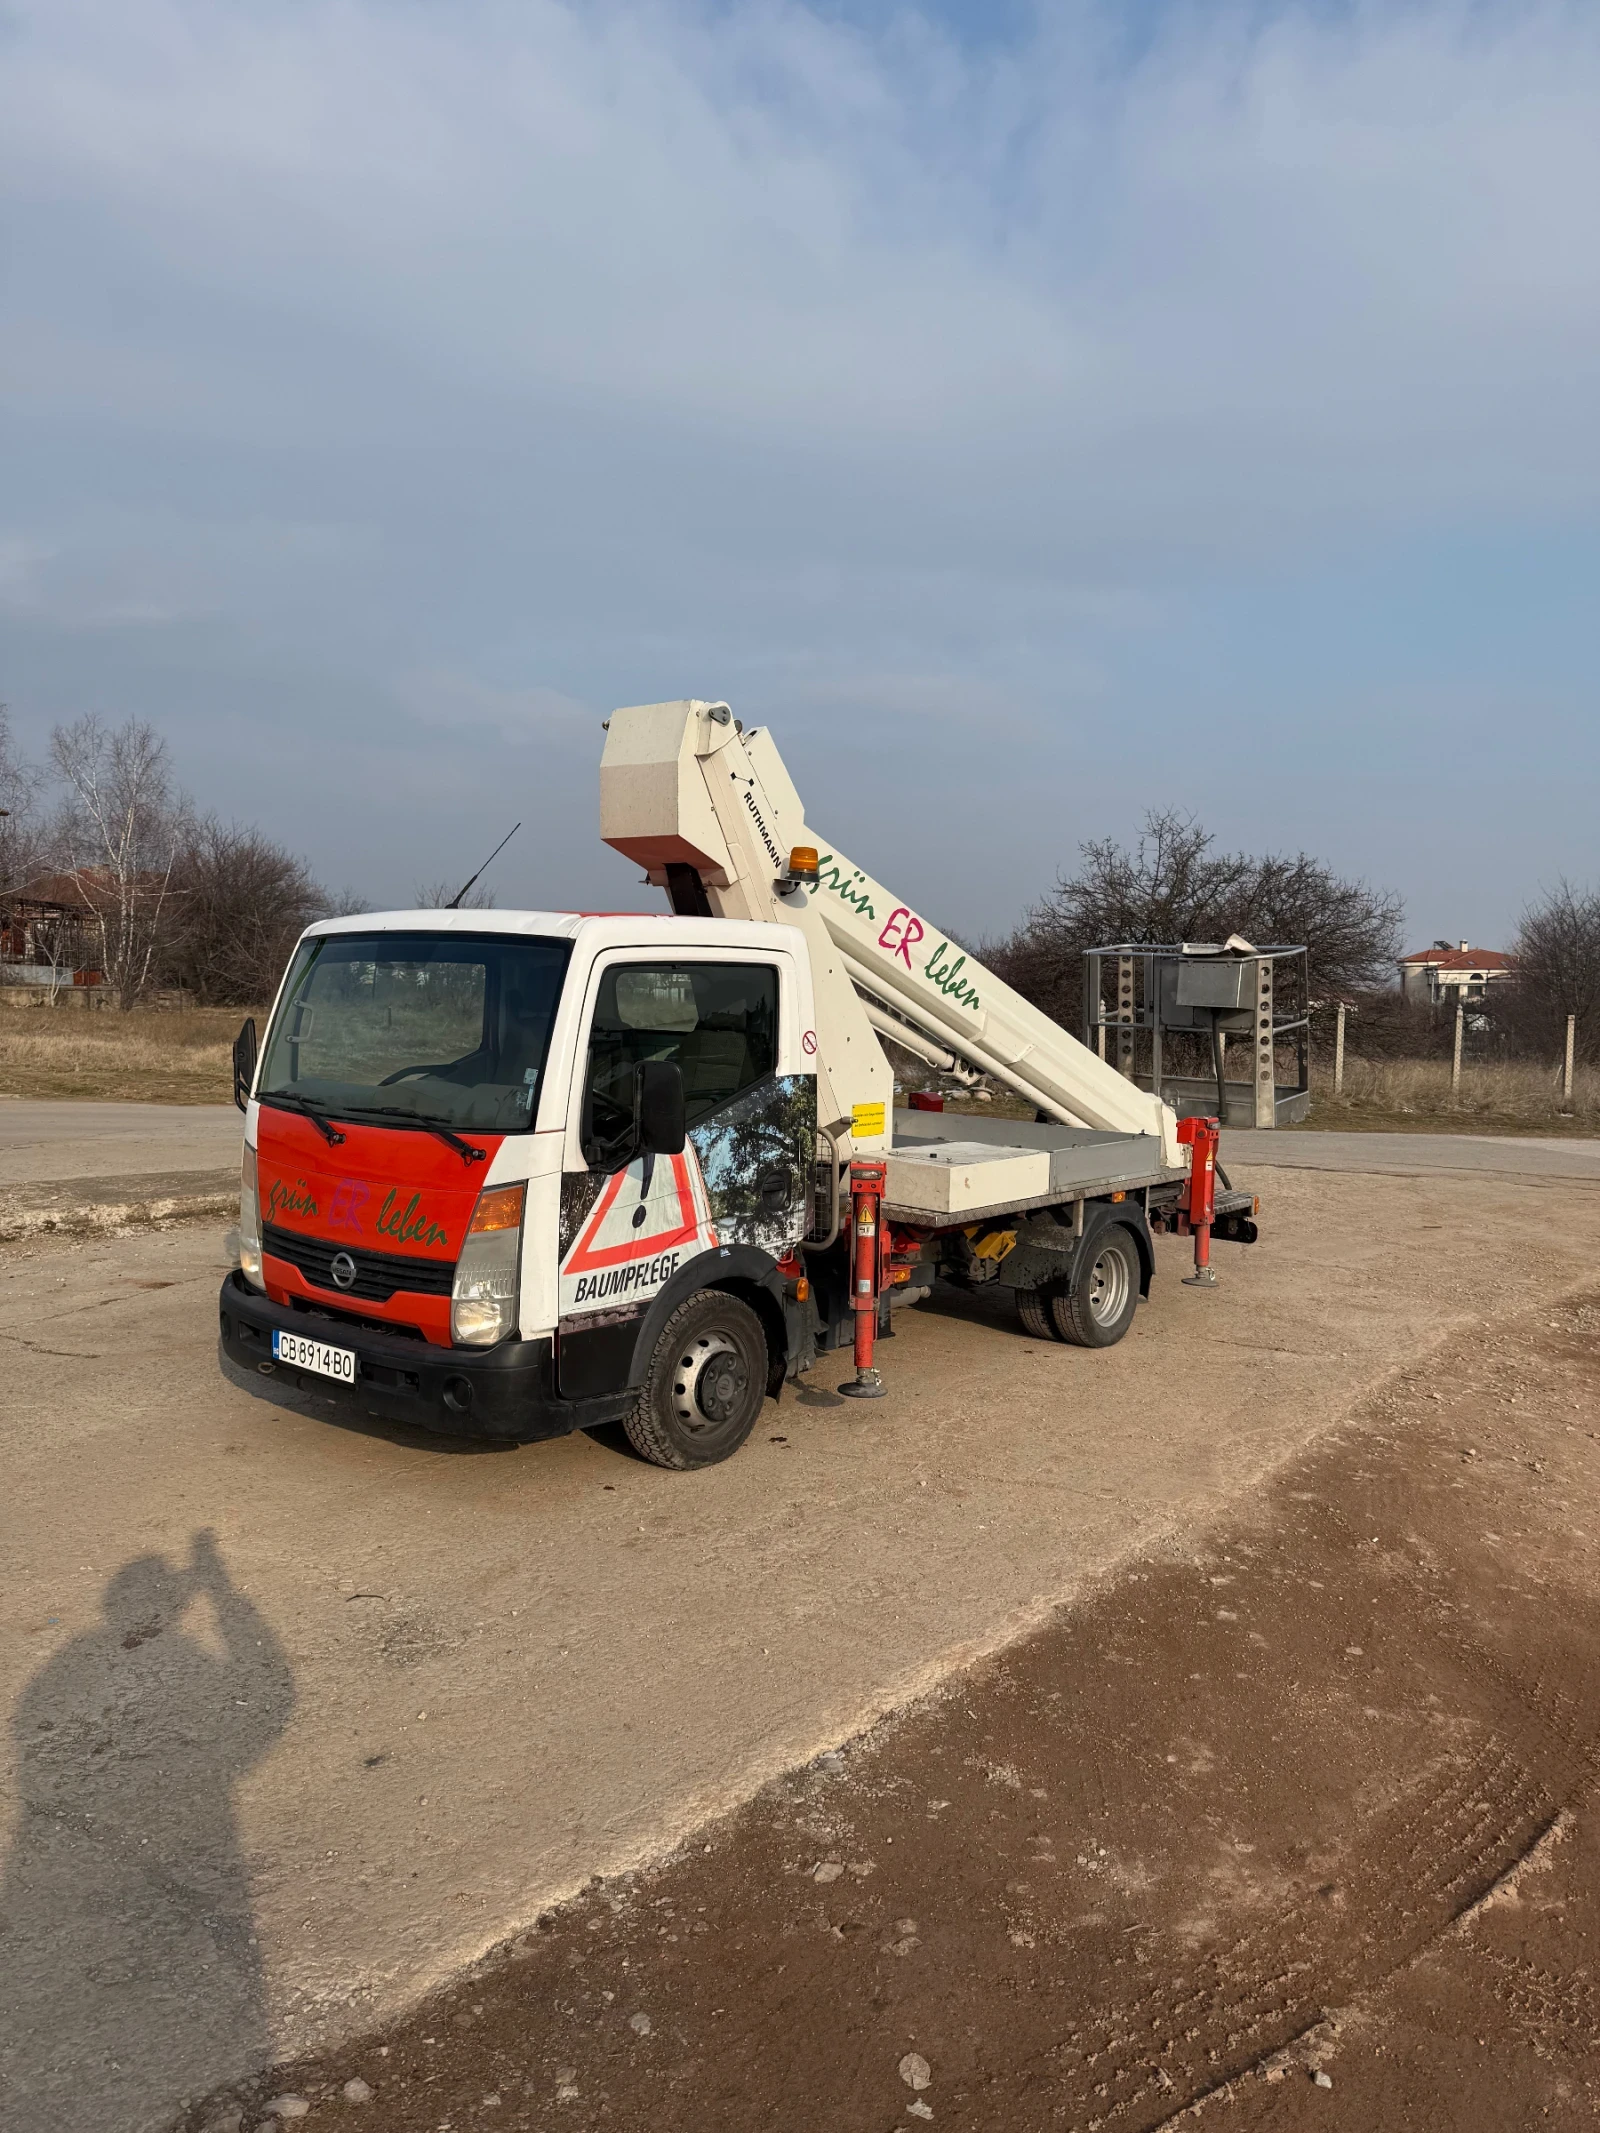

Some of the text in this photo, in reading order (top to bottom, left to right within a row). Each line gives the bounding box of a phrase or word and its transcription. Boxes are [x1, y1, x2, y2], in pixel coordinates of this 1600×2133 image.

[743, 791, 782, 869] RUTHMANN
[878, 908, 924, 970] ER
[924, 942, 979, 1010] leben
[266, 1178, 448, 1247] grün ER leben
[574, 1252, 680, 1303] BAUMPFLEGE
